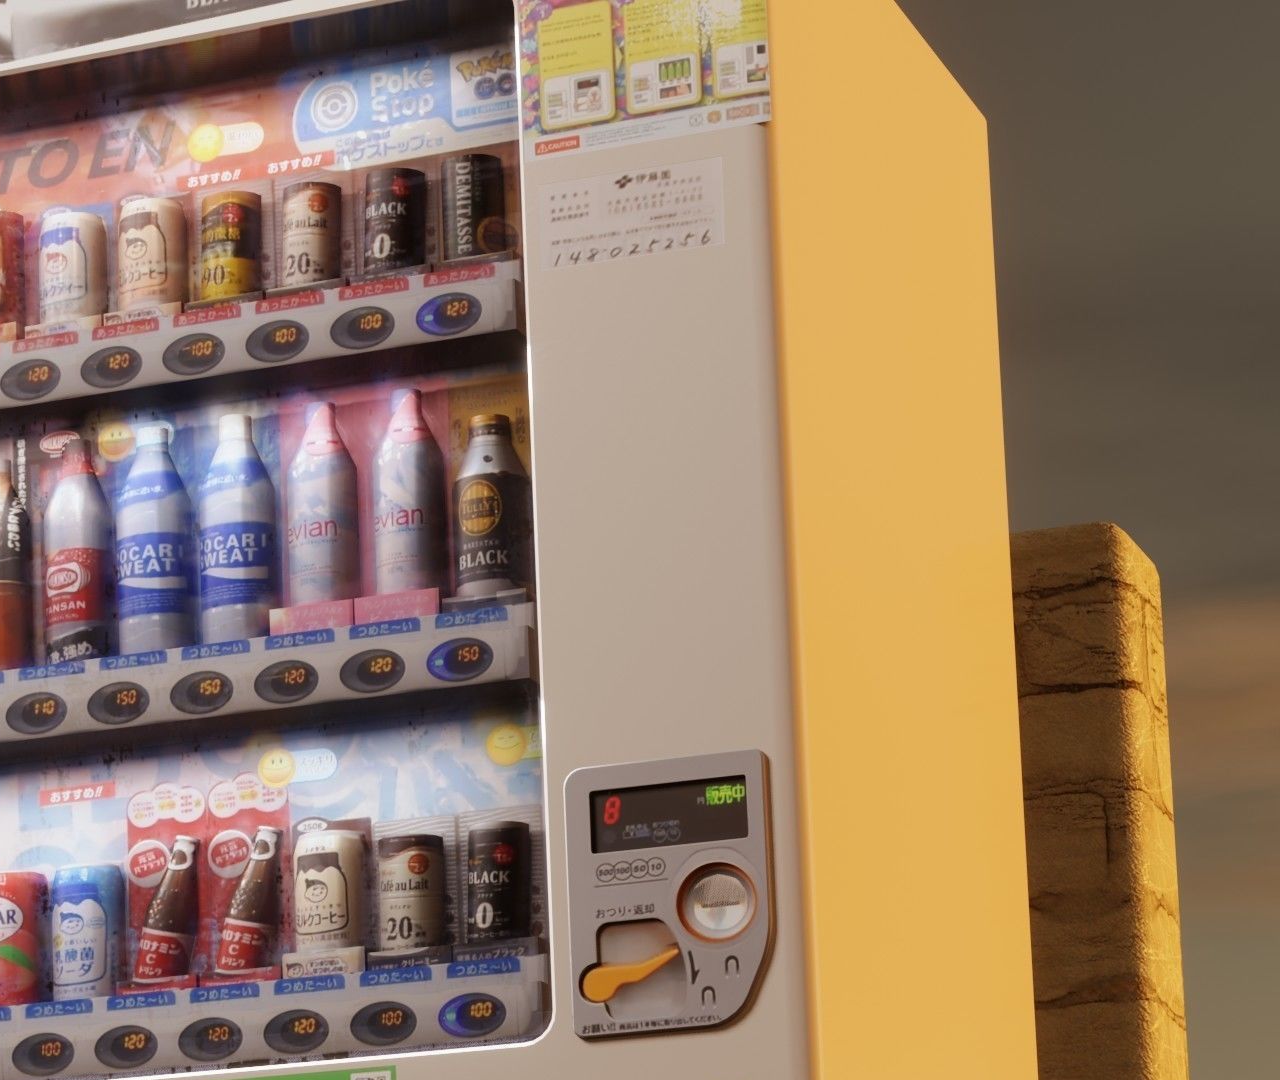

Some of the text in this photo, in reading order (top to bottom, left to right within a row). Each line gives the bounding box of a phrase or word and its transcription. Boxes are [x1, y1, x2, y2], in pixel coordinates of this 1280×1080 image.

[370, 62, 436, 97] Poké
[371, 93, 435, 122] Stop
[88, 120, 177, 179] EN
[366, 202, 408, 218] BLACK
[455, 160, 474, 255] DEMITASSE
[285, 252, 311, 277] 20
[446, 300, 468, 316] 120
[360, 314, 382, 330] 100
[274, 328, 296, 344] 100
[108, 354, 130, 369] 120
[26, 367, 48, 382] 120
[374, 505, 425, 533] evian
[288, 518, 340, 544] evian
[458, 548, 509, 571] BLACK
[46, 599, 86, 614] TANSAN
[456, 645, 479, 662] 150
[370, 657, 393, 673] 120
[284, 668, 306, 685] 120
[199, 678, 221, 695] 150
[115, 689, 137, 705] 150
[33, 700, 55, 716] 110
[651, 862, 662, 871] 10
[408, 877, 429, 891] Lait
[468, 870, 510, 886] BLACK
[476, 902, 494, 929] 0
[595, 903, 656, 919] おつり・返却
[386, 914, 413, 942] 20
[228, 945, 238, 956] C
[145, 954, 156, 964] C
[56, 961, 95, 978] ソーダ
[380, 1010, 403, 1026] 100
[470, 1002, 492, 1018] 100
[207, 1026, 230, 1042] 120
[293, 1018, 316, 1034] 120
[124, 1033, 146, 1049] 120
[40, 1042, 61, 1057] 100
